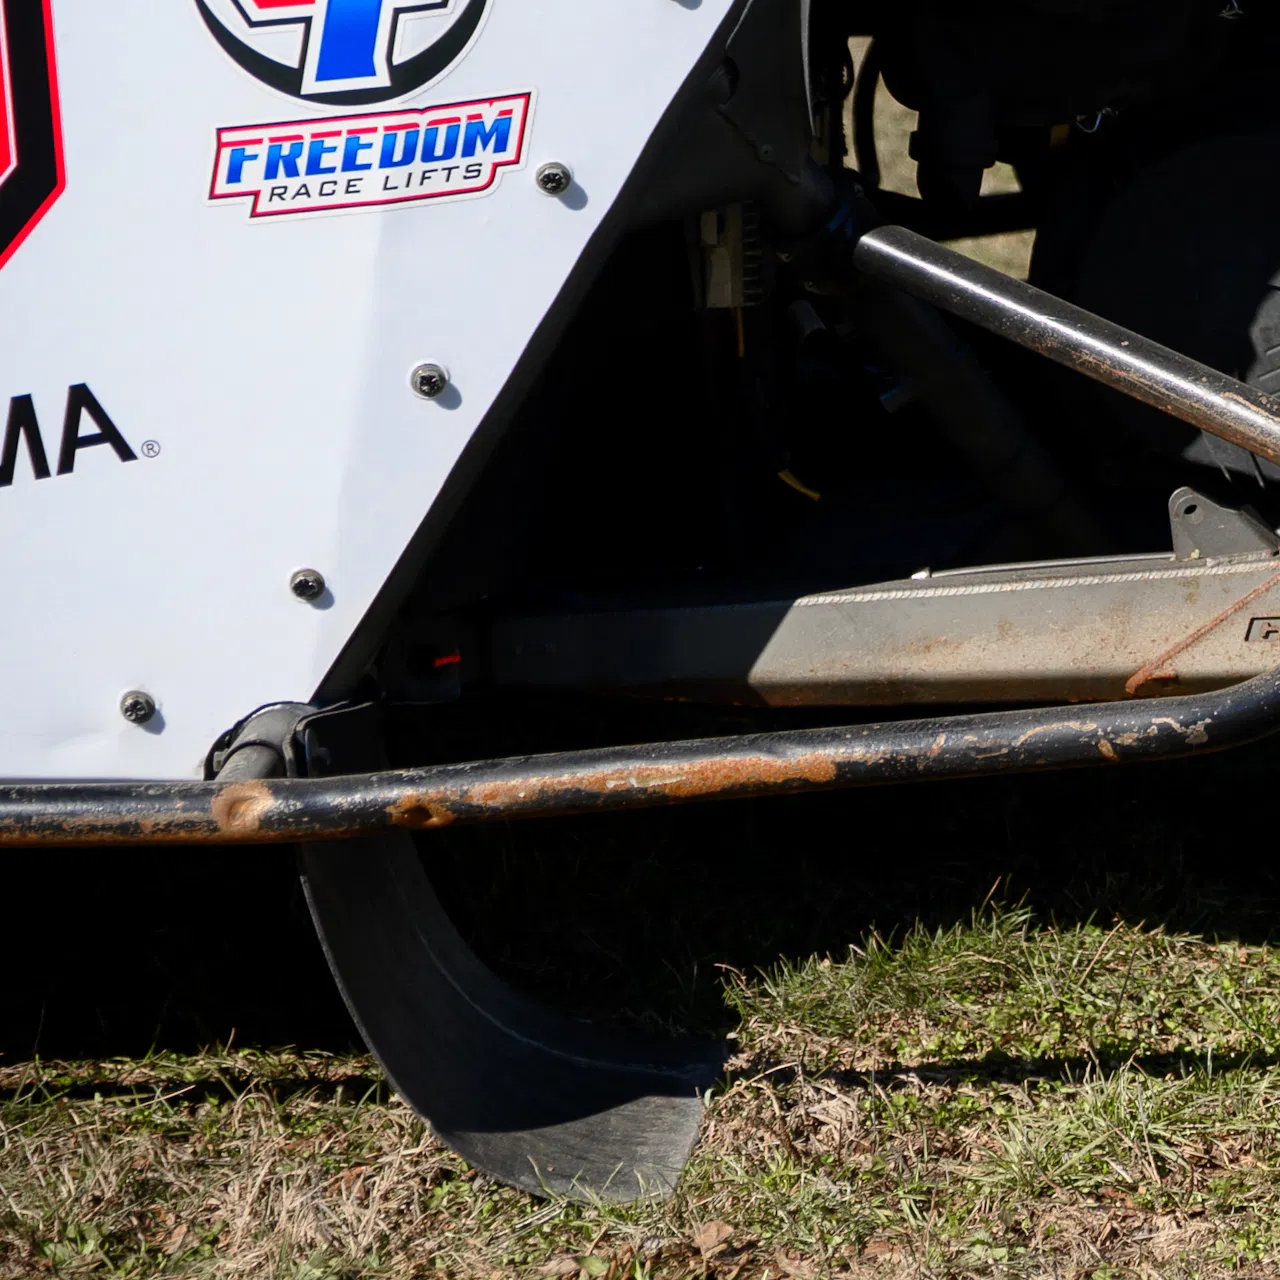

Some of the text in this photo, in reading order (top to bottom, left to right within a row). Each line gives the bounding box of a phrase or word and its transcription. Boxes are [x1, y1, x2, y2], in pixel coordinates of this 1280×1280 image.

[220, 108, 514, 185] FREEDOM
[268, 162, 483, 203] RACE LIFTS
